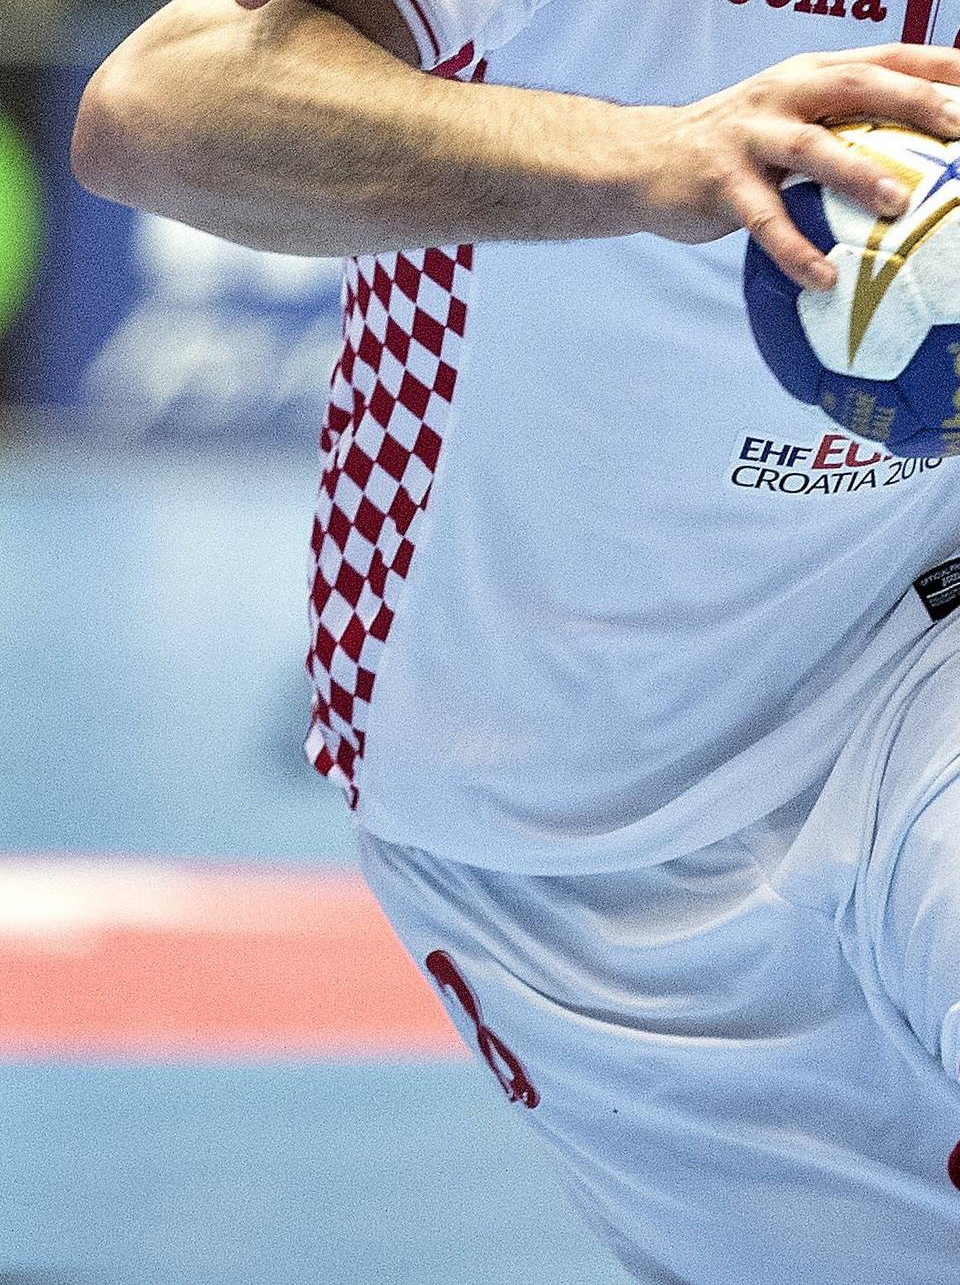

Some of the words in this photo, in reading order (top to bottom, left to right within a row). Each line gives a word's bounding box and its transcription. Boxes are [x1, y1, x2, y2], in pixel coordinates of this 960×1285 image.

[738, 436, 813, 467] EHF
[811, 433, 894, 470] EU
[730, 465, 877, 496] CROATIA
